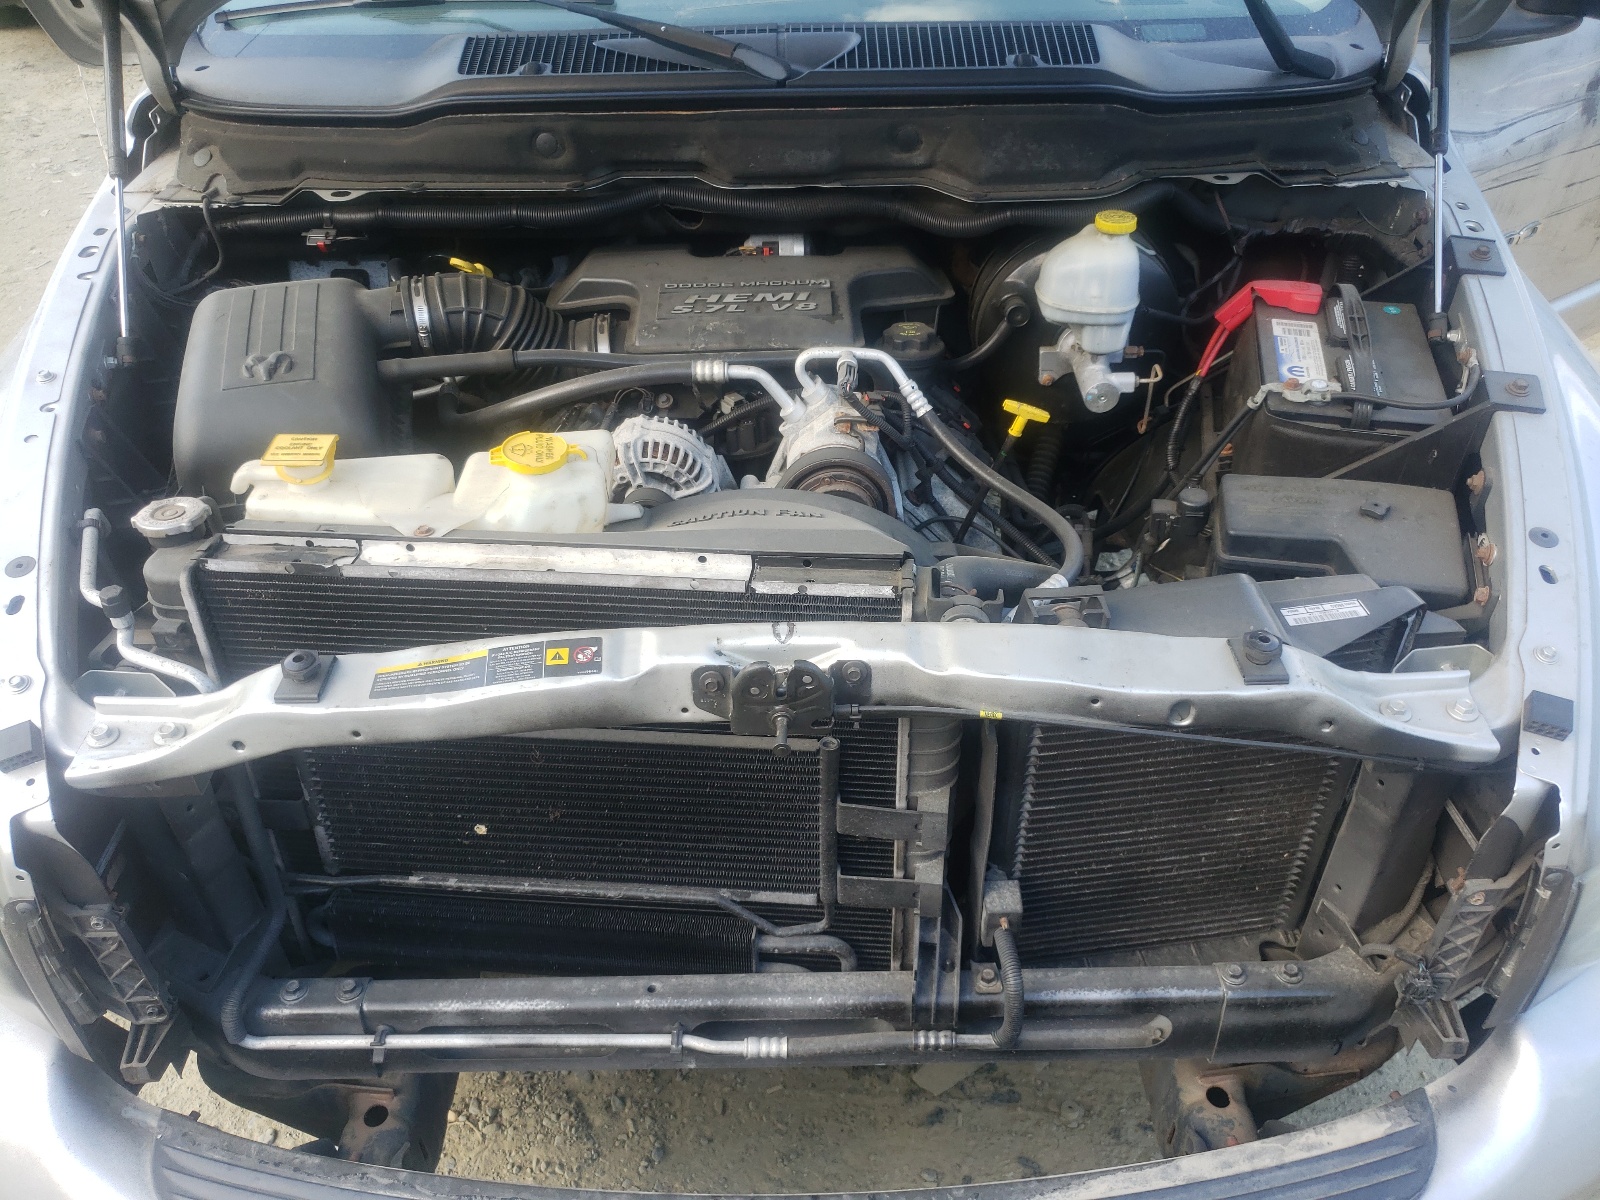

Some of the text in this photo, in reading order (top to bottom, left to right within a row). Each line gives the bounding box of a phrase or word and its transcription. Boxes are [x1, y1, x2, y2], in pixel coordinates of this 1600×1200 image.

[664, 279, 831, 290] DODGE MAGNUM
[683, 291, 812, 305] HEMI
[670, 302, 818, 315] 5.7L V8
[545, 436, 555, 460] WASHER
[535, 449, 544, 464] ONLY
[667, 508, 826, 528] CAUTION FAN
[422, 657, 450, 667] WARNING
